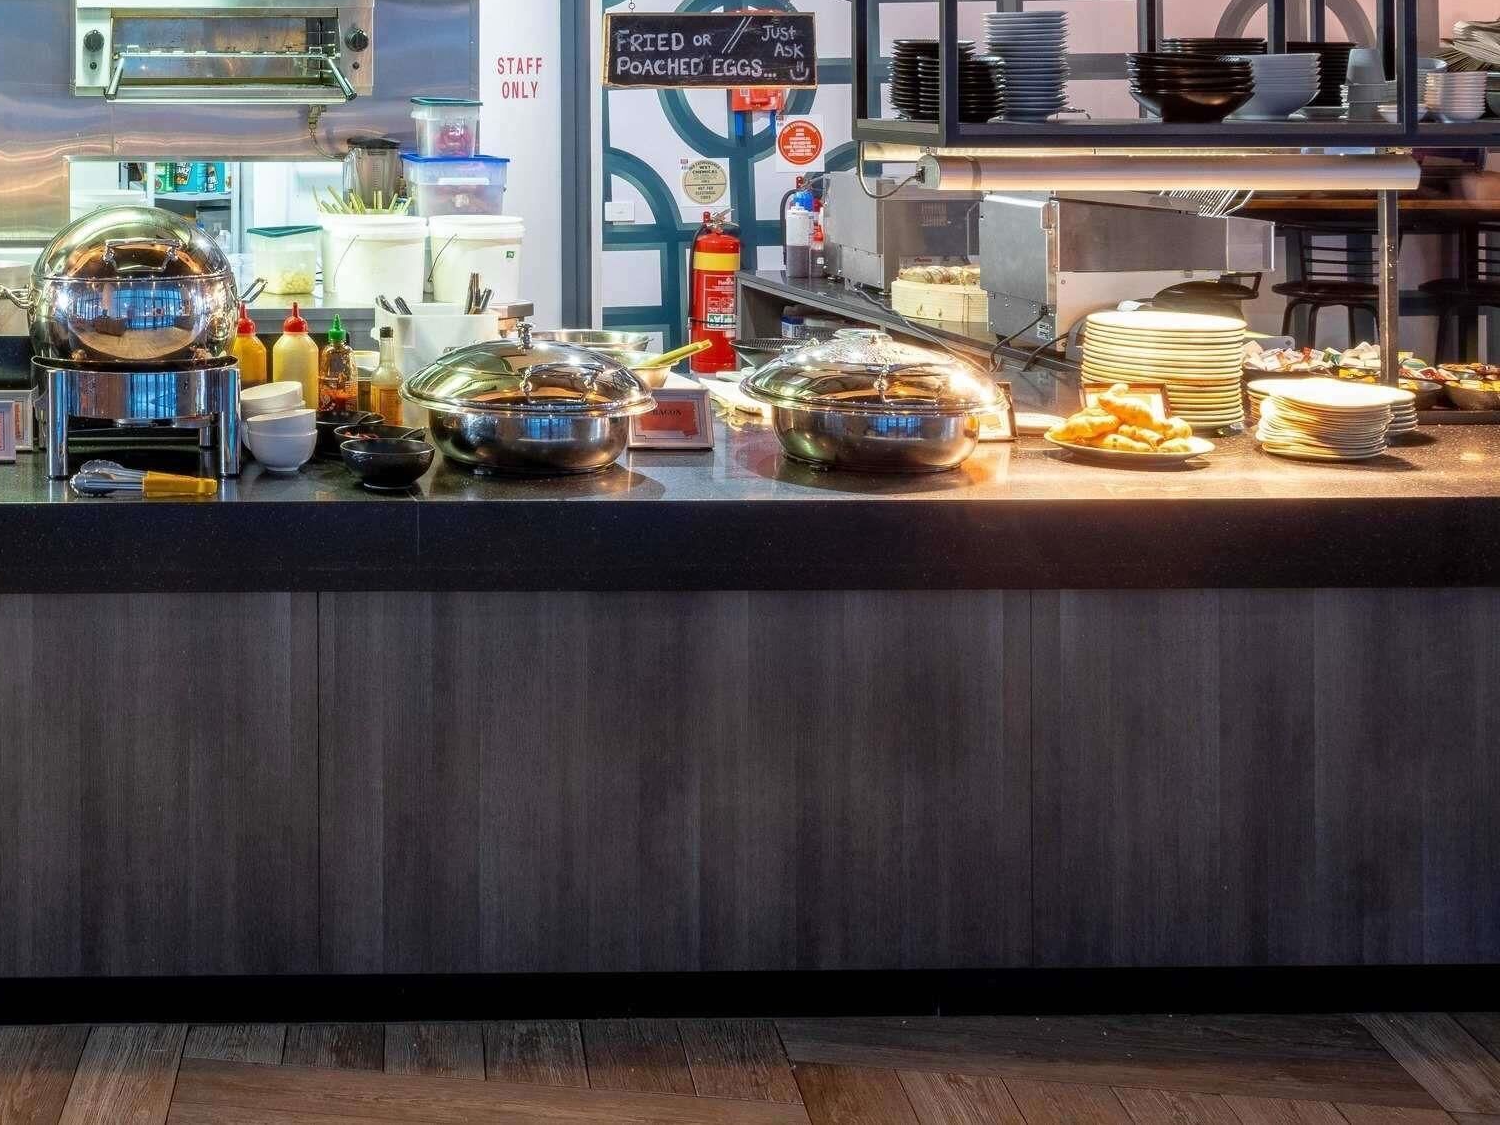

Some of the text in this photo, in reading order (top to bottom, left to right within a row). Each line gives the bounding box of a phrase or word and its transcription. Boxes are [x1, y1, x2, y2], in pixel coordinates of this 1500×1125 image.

[616, 30, 712, 52] FRIED OR
[497, 57, 543, 75] STAFF
[616, 56, 704, 76] POACHED
[501, 81, 539, 99] ONLY
